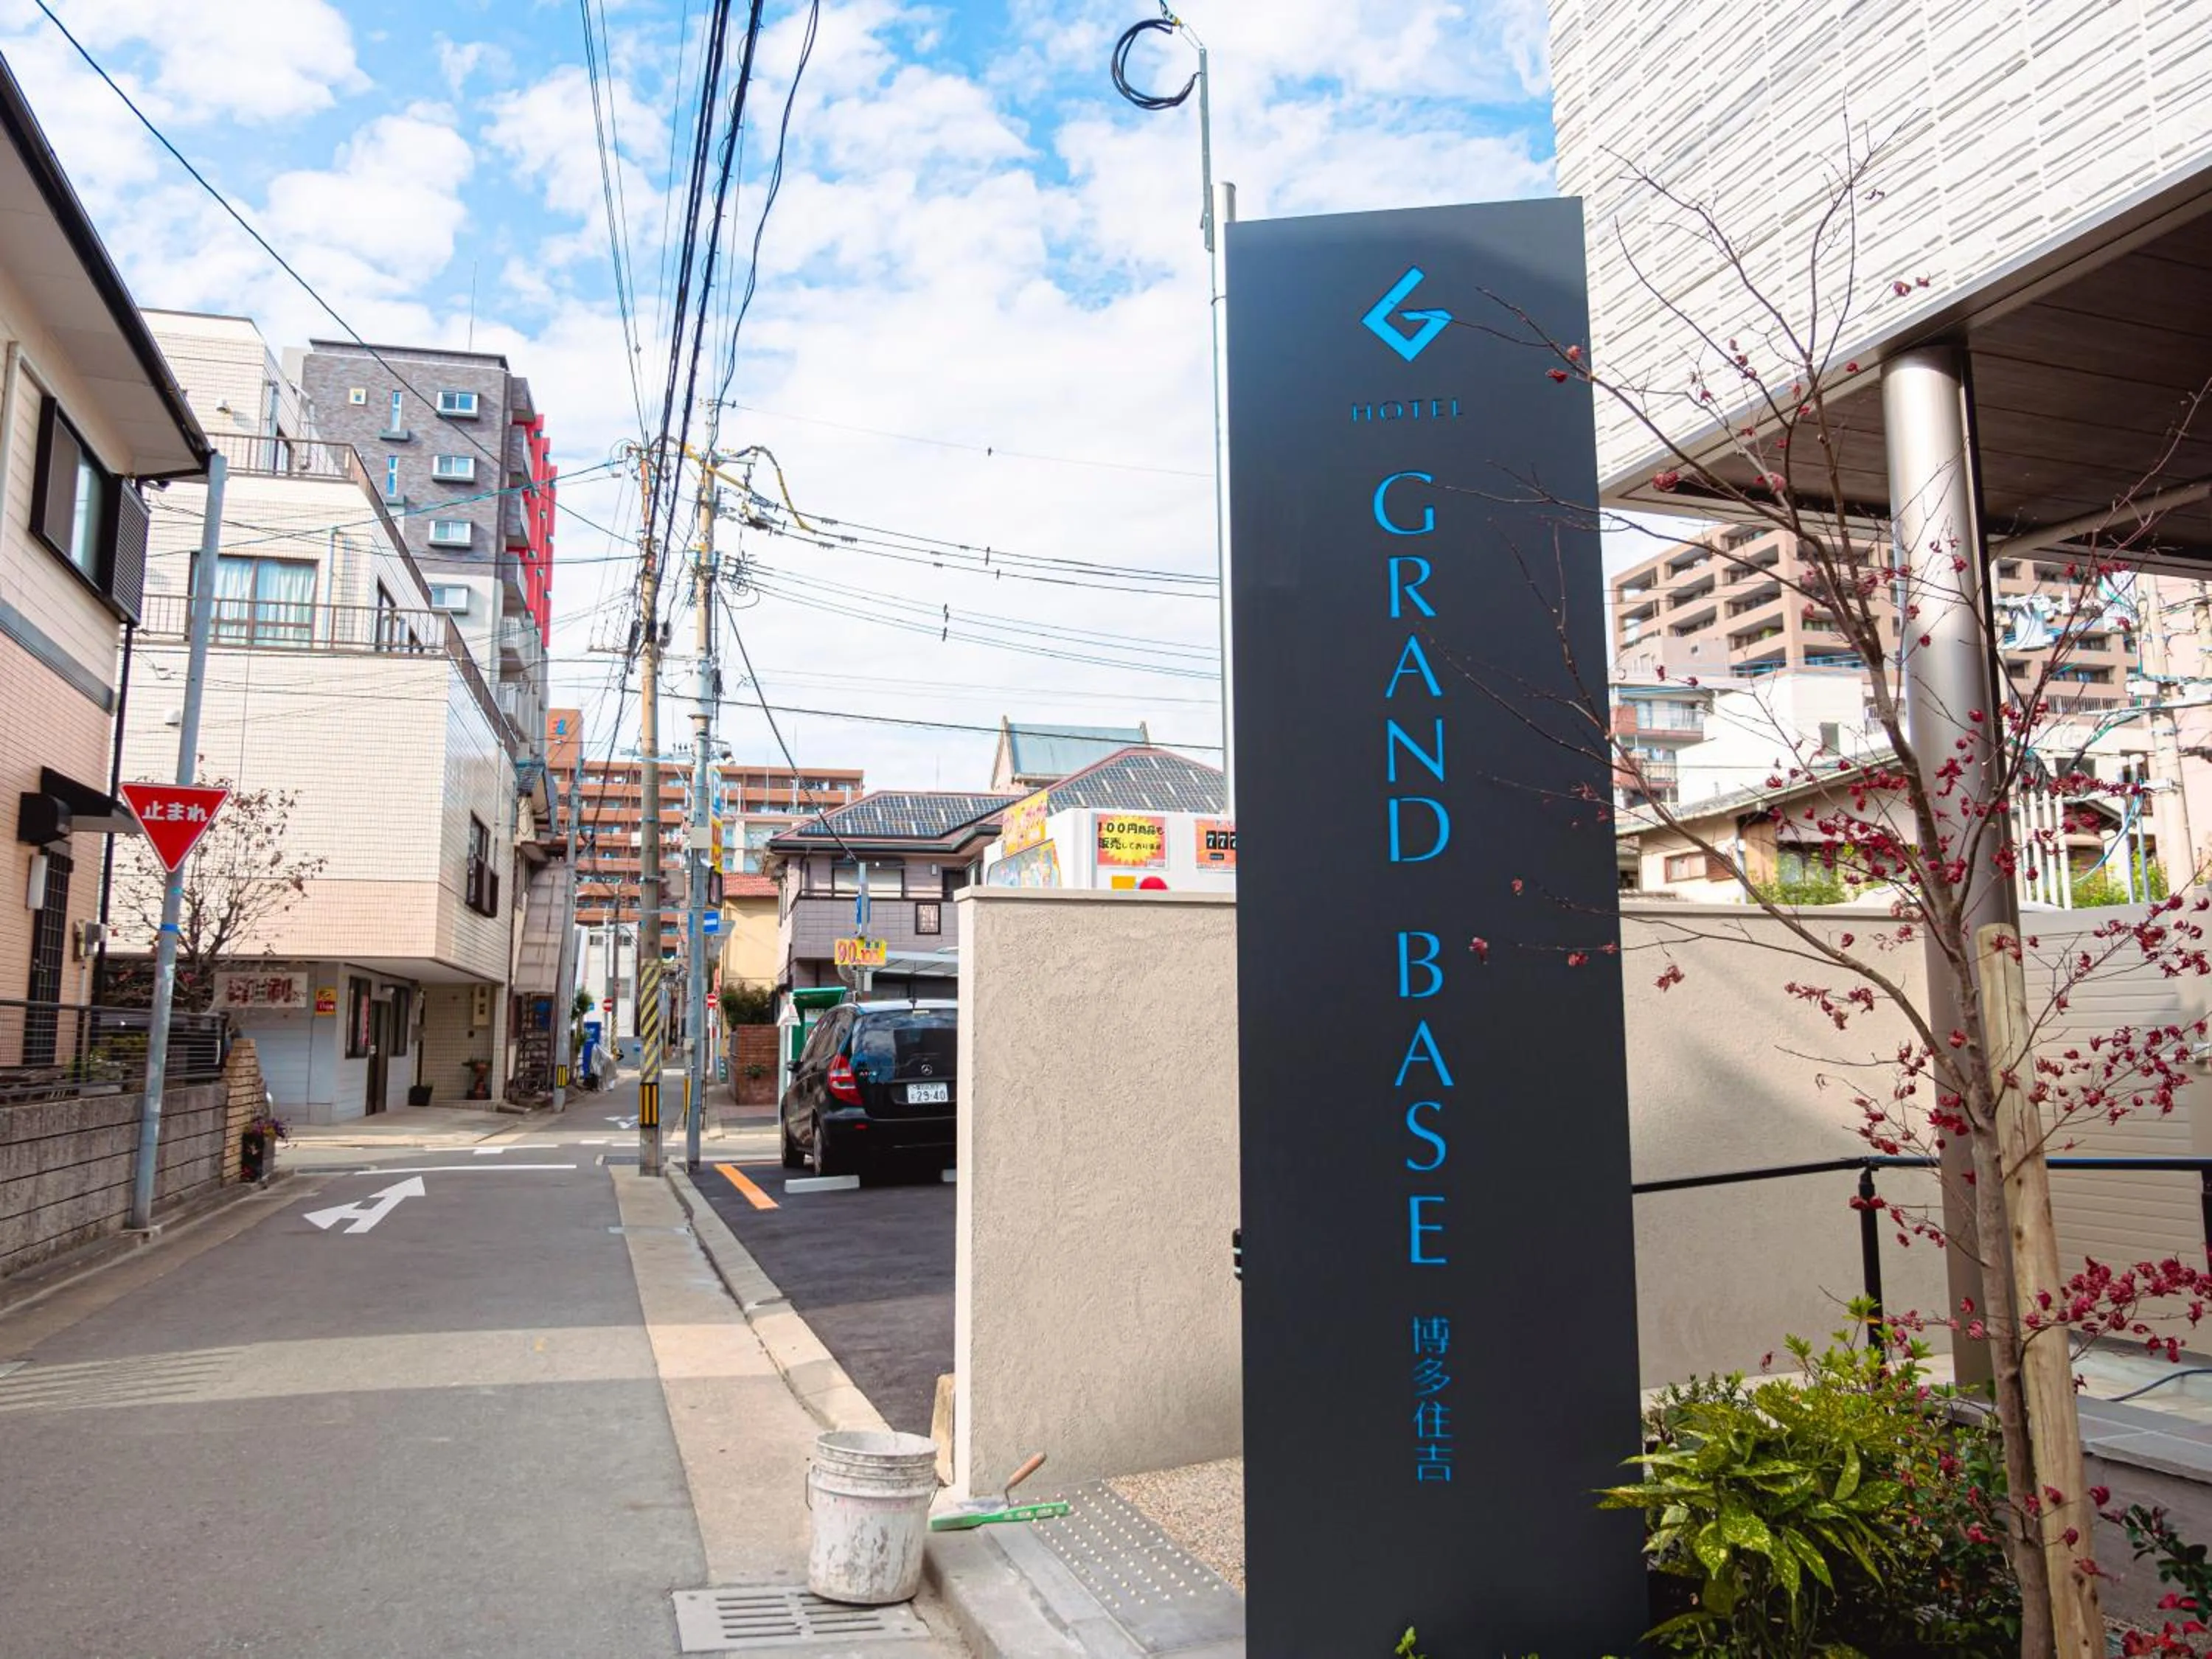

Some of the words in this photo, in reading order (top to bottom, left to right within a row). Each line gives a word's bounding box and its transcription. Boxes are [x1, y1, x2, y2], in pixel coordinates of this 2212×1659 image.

[1352, 397, 1463, 422] HOTEL
[1372, 470, 1451, 864] GRAND
[142, 800, 208, 822] 止まれ
[1394, 931, 1455, 1267] BASE
[1413, 1316, 1453, 1484] 博多住吉
